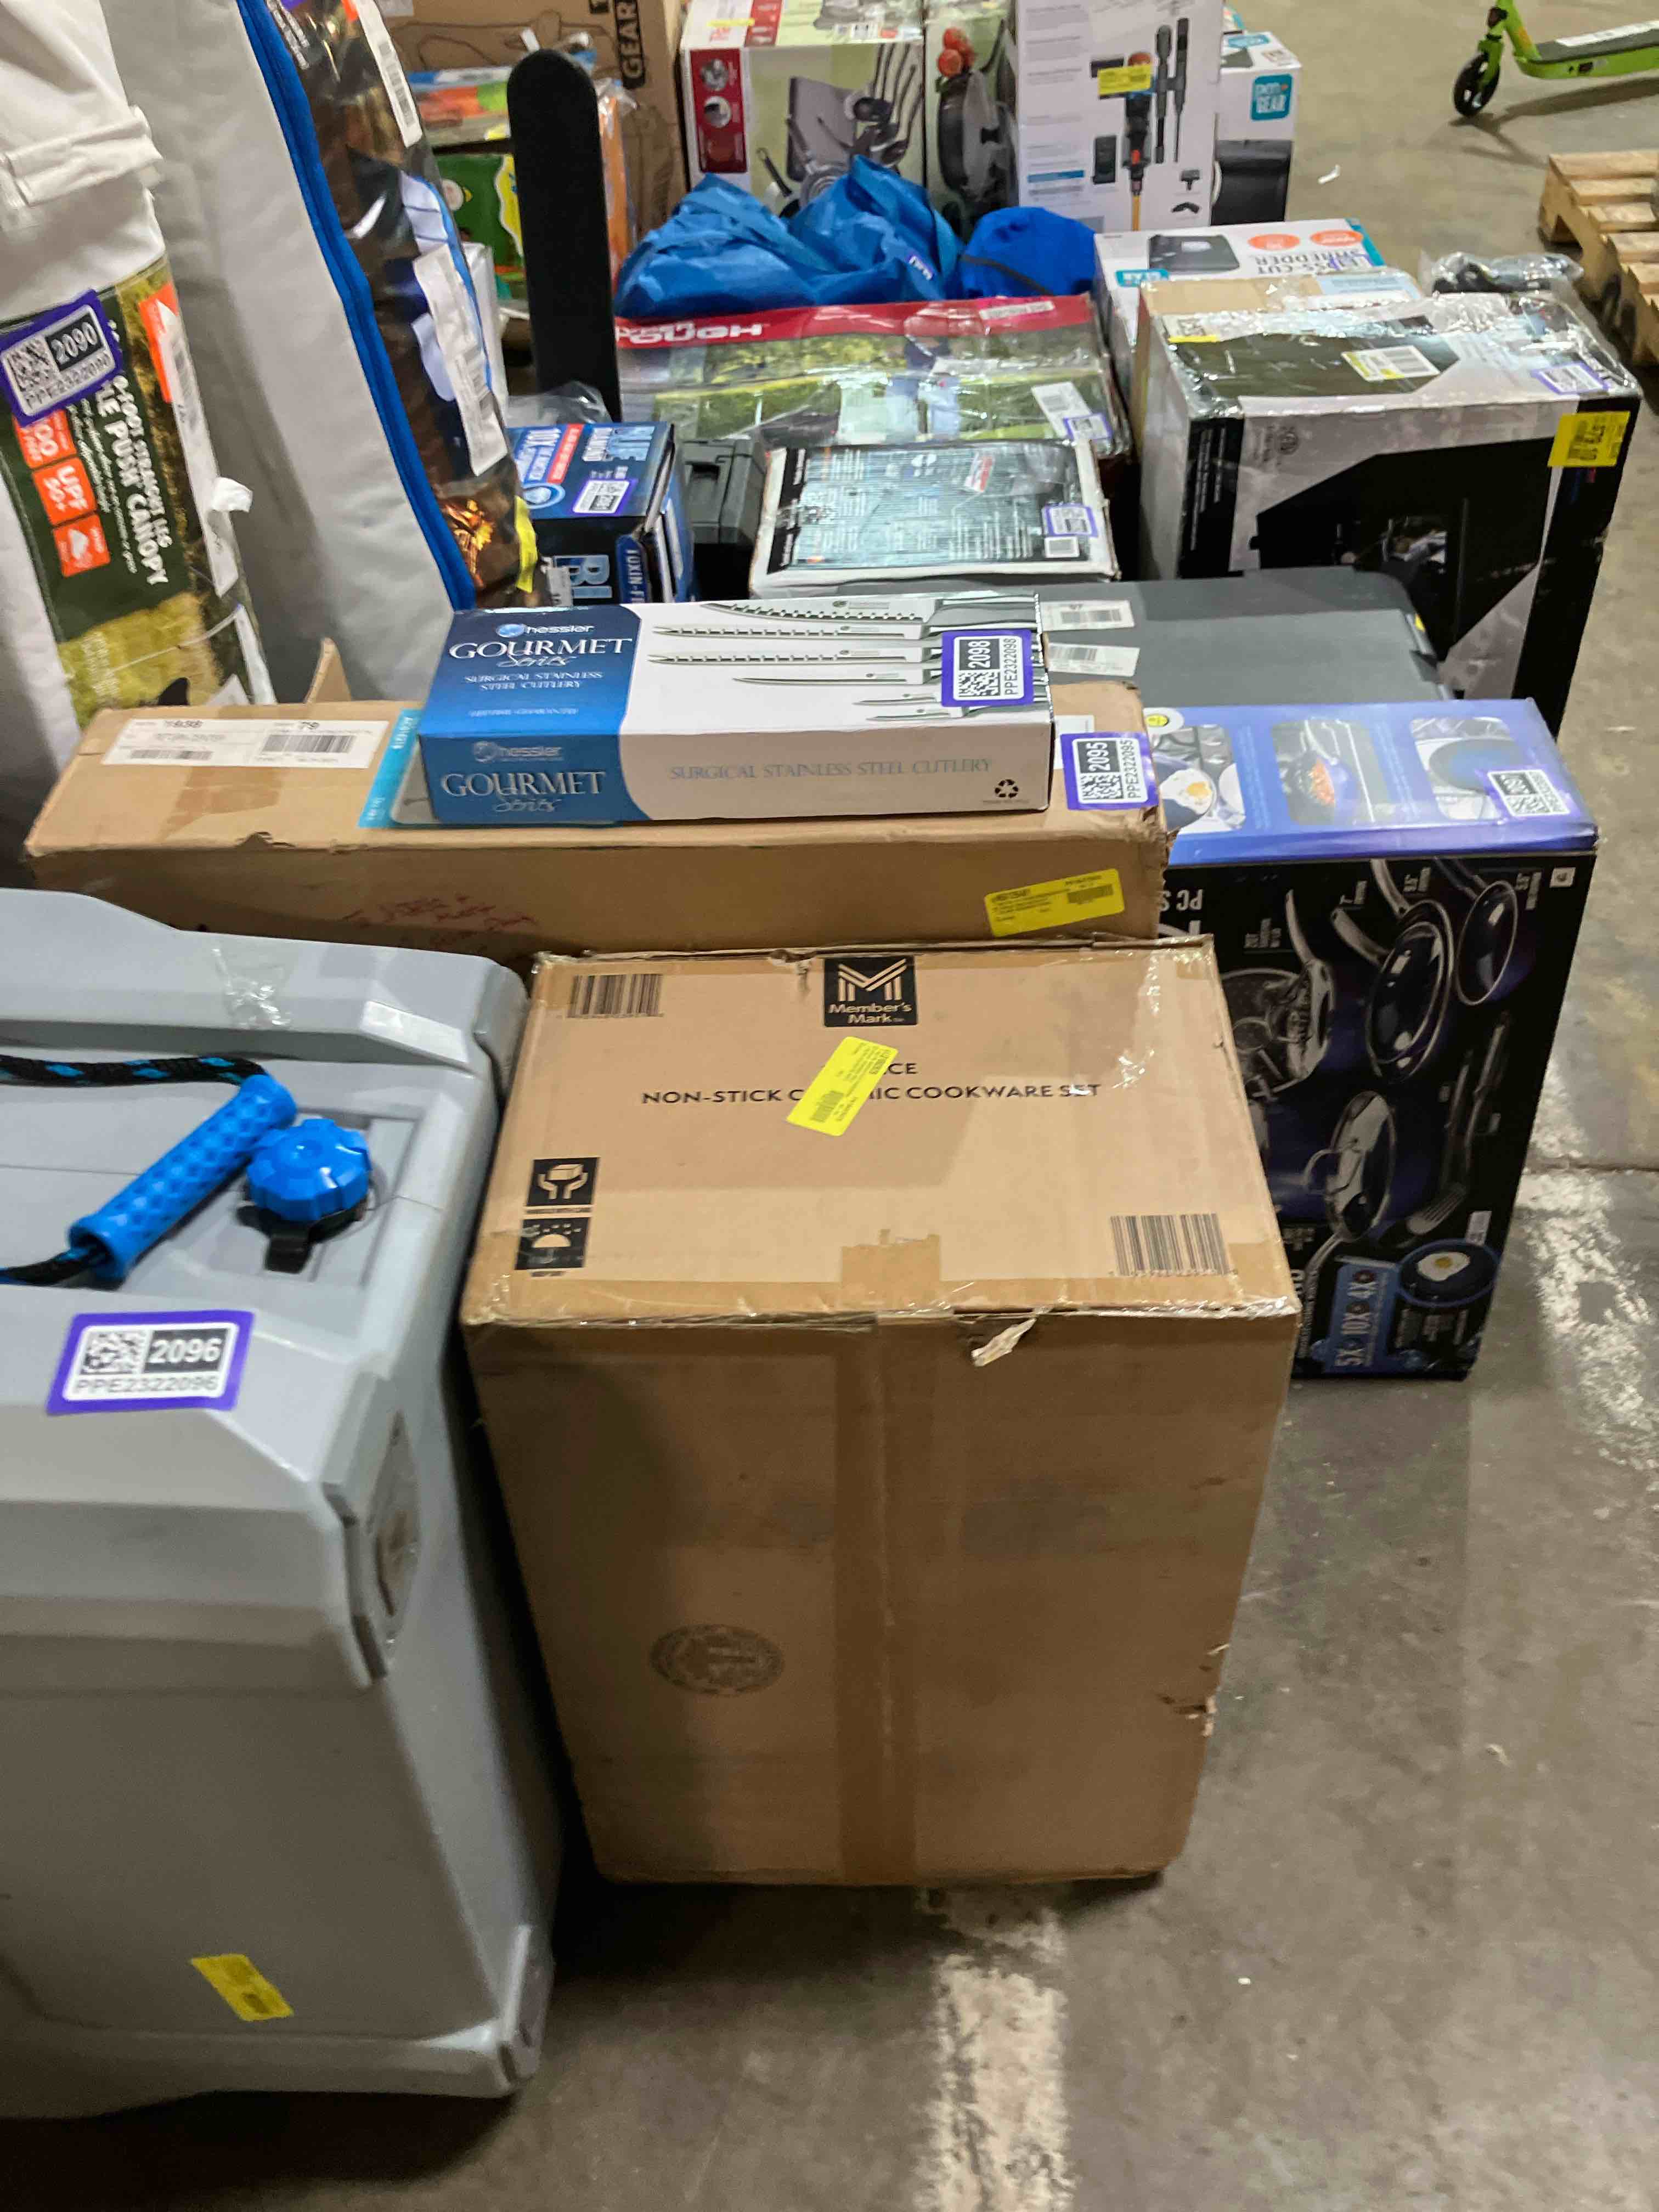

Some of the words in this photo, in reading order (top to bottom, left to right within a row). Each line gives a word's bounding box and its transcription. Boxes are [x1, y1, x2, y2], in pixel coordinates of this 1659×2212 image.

[616, 1, 643, 79] GEAR
[1255, 95, 1287, 113] GEAR
[50, 321, 98, 365] 2090
[57, 465, 89, 511] UPF
[104, 420, 142, 488] PUSH
[126, 493, 169, 585] CANOPY
[448, 638, 633, 660] GOURMET
[968, 640, 991, 669] 2098
[465, 672, 531, 683] SURGICAL
[1003, 637, 1020, 697] PPE2322098
[669, 765, 757, 780] SURGICAL
[762, 762, 853, 778] STAINLESS
[856, 760, 906, 776] STEEL
[911, 756, 992, 775] CUTLERY
[1086, 741, 1111, 772] 2095
[1119, 738, 1142, 799] PPE2322095
[439, 771, 607, 798] GOURMET
[1176, 888, 1204, 911] PC
[828, 1002, 913, 1014] Member's
[847, 1013, 893, 1024] Mark
[641, 1088, 782, 1104] NON-STICK
[901, 1085, 1056, 1101] COOKWARE
[146, 1338, 222, 1364] 2096
[74, 1374, 219, 1396] PPE2322096
